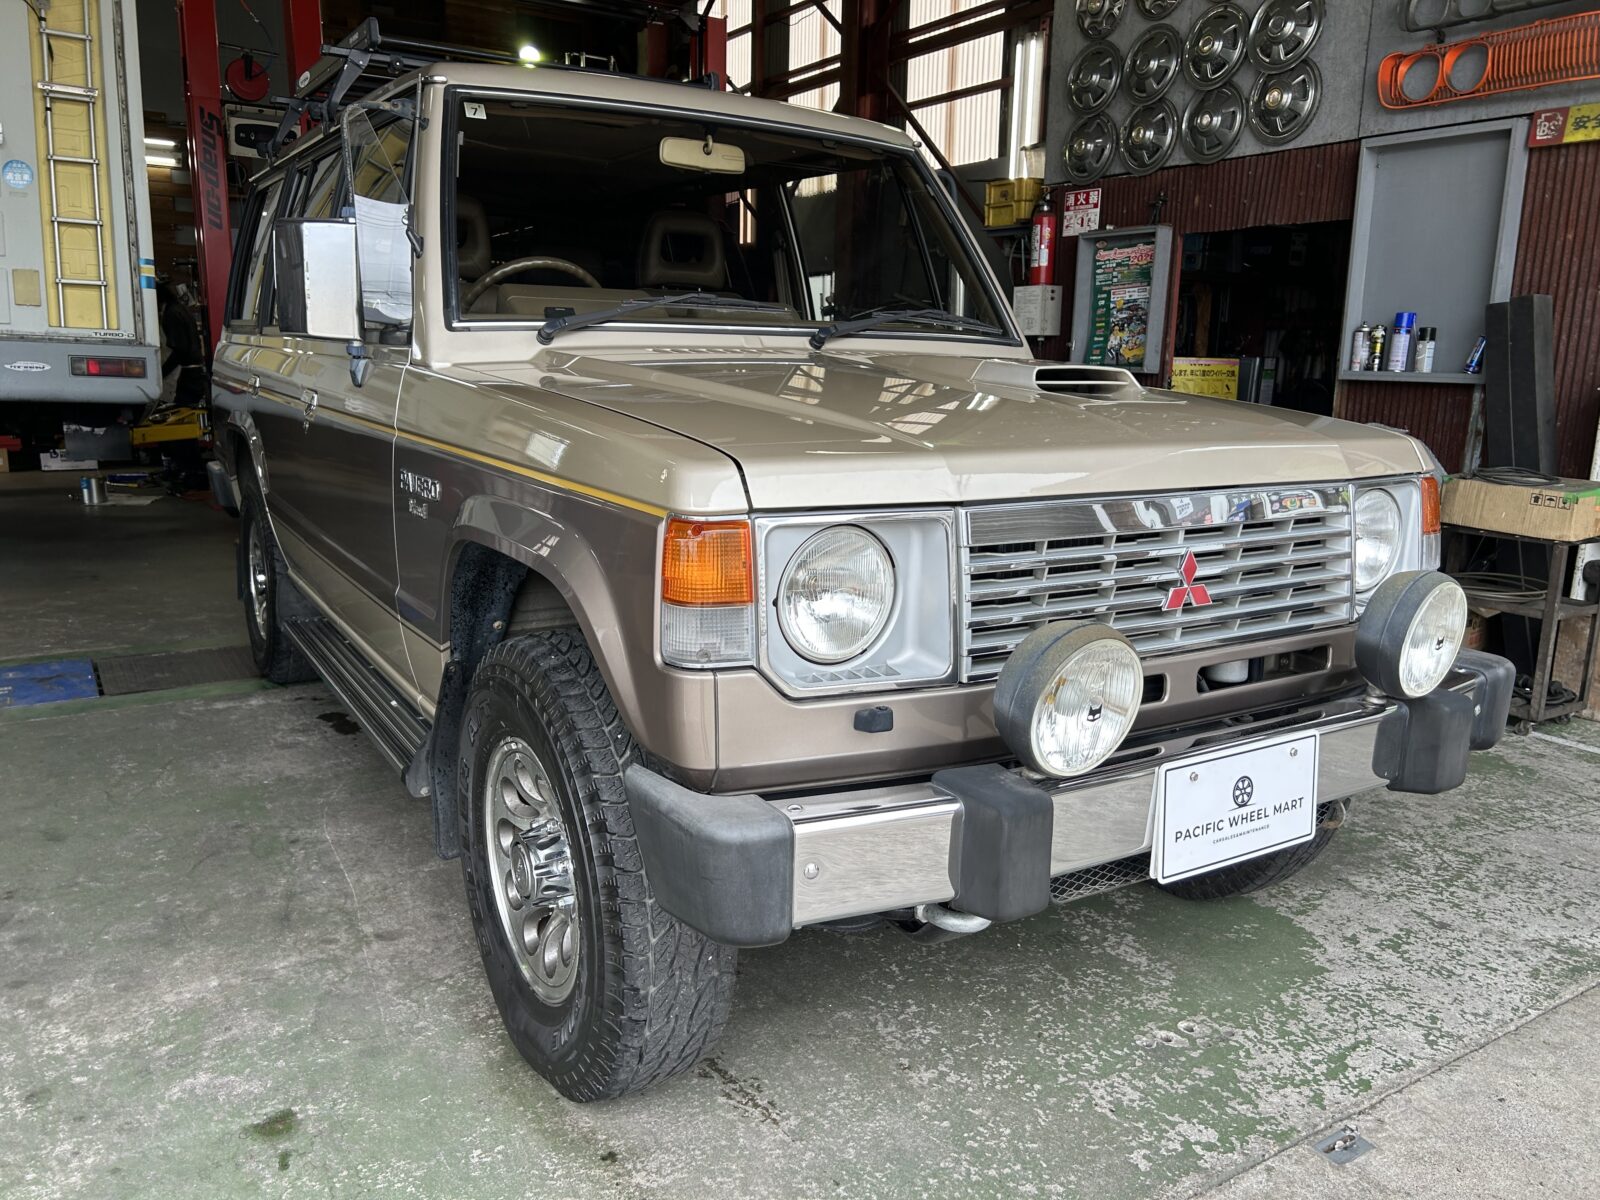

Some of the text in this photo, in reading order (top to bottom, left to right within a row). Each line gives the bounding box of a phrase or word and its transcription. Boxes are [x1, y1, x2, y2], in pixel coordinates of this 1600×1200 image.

[470, 106, 478, 116] 7
[1066, 191, 1099, 207] 消火器
[1175, 797, 1304, 843] PACIFIC WHEEL MART
